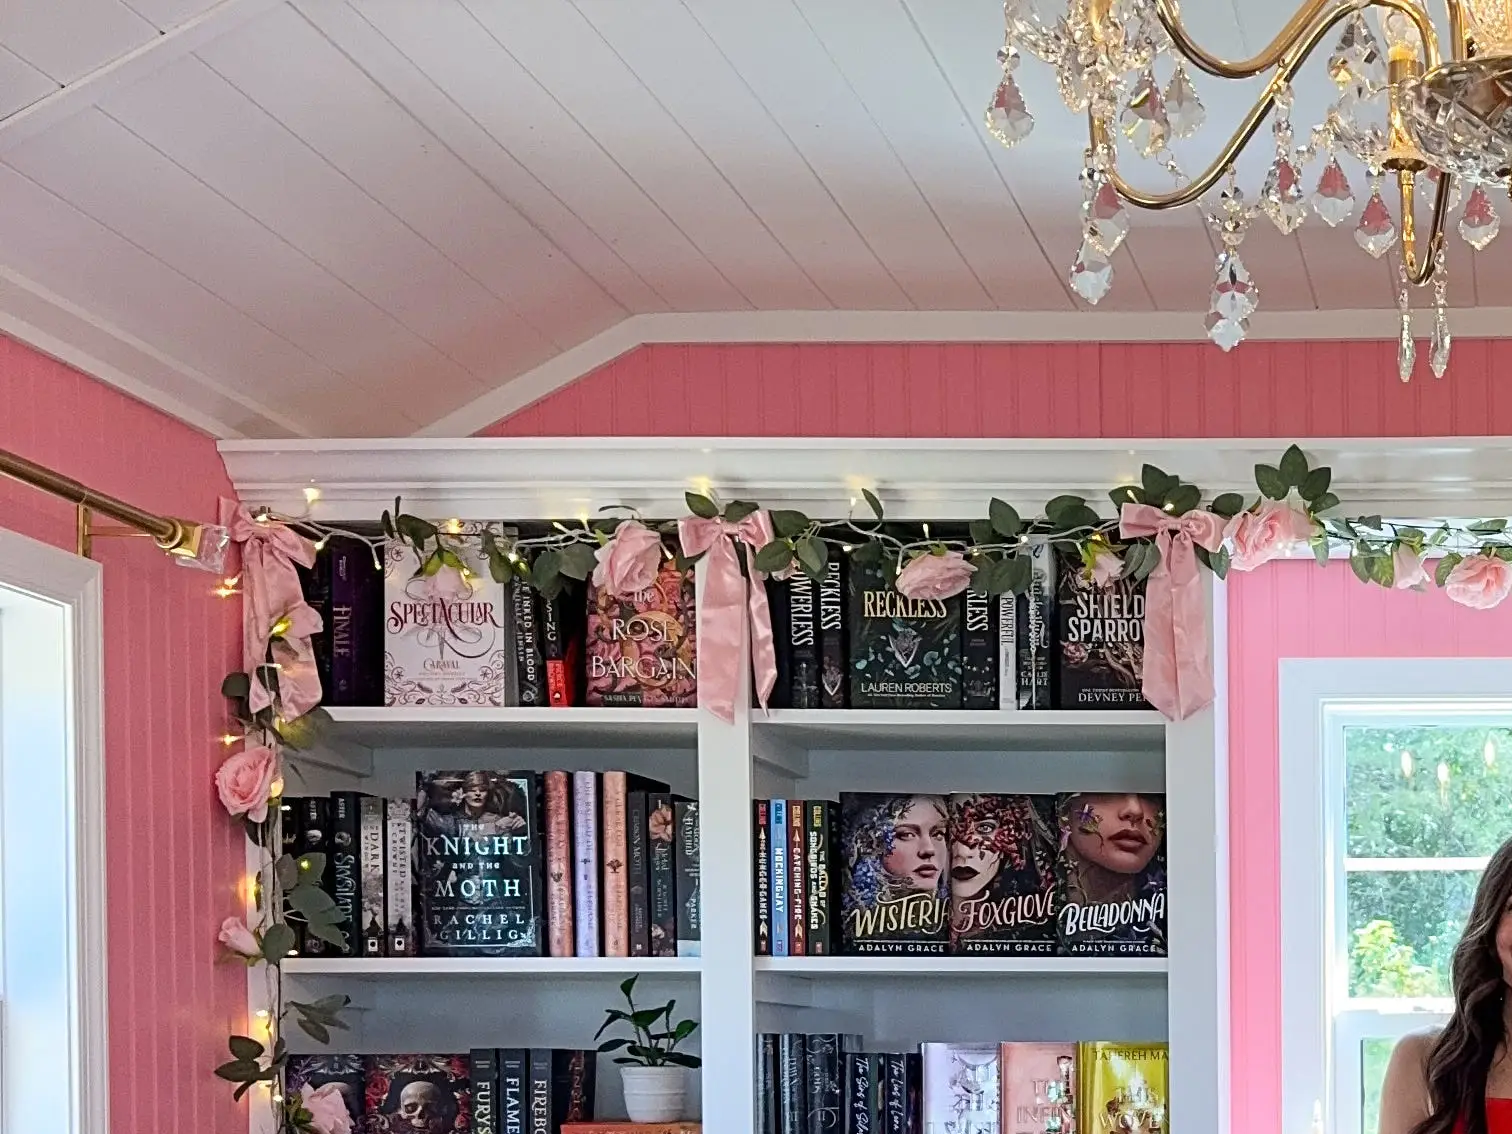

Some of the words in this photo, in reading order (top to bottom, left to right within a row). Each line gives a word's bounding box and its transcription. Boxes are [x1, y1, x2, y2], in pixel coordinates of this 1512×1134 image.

[389, 598, 503, 634] SPECTACULAR
[522, 596, 534, 628] INKED
[1076, 592, 1145, 619] SHIELD
[333, 605, 353, 657] FINALE
[612, 618, 674, 643] ROSE
[1001, 597, 1015, 646] POWERFUL
[525, 632, 534, 643] IN
[526, 648, 538, 681] BLOOD
[592, 655, 697, 680] BARGAIN
[861, 682, 903, 693] LAUREN
[904, 682, 953, 693] ROBERTS
[1078, 692, 1124, 702] DEVNEY
[370, 833, 380, 873] DARK
[427, 835, 529, 856] KNIGHT
[774, 847, 784, 912] MOCKINGJAY
[793, 847, 802, 895] CATCHING
[434, 879, 521, 897] MOTH
[434, 914, 525, 925] RACHEL
[793, 898, 802, 920] FIRE
[952, 883, 1056, 933] FOXGLOVE
[1059, 892, 1165, 936] BELLADONNA
[440, 929, 518, 940] GILLIG
[858, 945, 903, 953] ADALYN
[907, 945, 945, 953] GRACE
[966, 944, 1011, 953] ADALYN
[1015, 944, 1052, 952] GRACE
